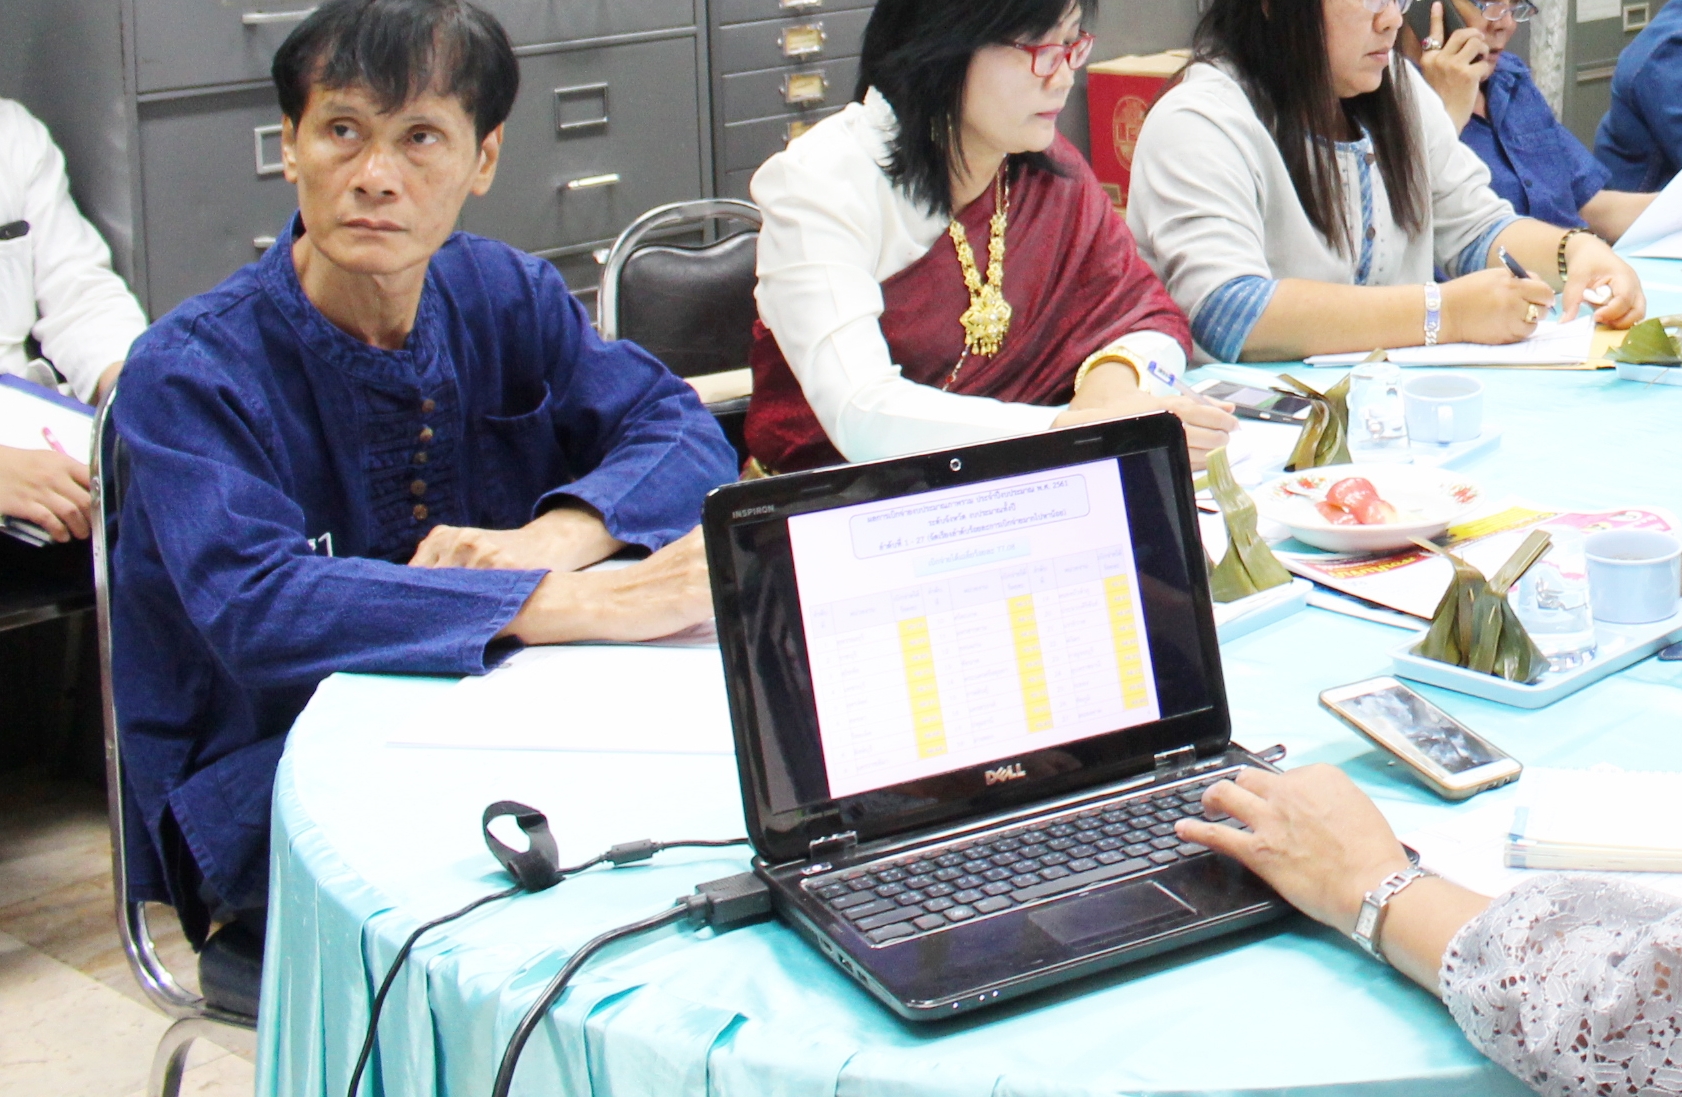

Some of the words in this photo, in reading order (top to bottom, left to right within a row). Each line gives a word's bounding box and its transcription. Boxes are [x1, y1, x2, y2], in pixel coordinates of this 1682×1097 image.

[1051, 479, 1068, 489] 2561
[732, 504, 774, 518] INSPIRON
[985, 763, 1026, 785] DELL
